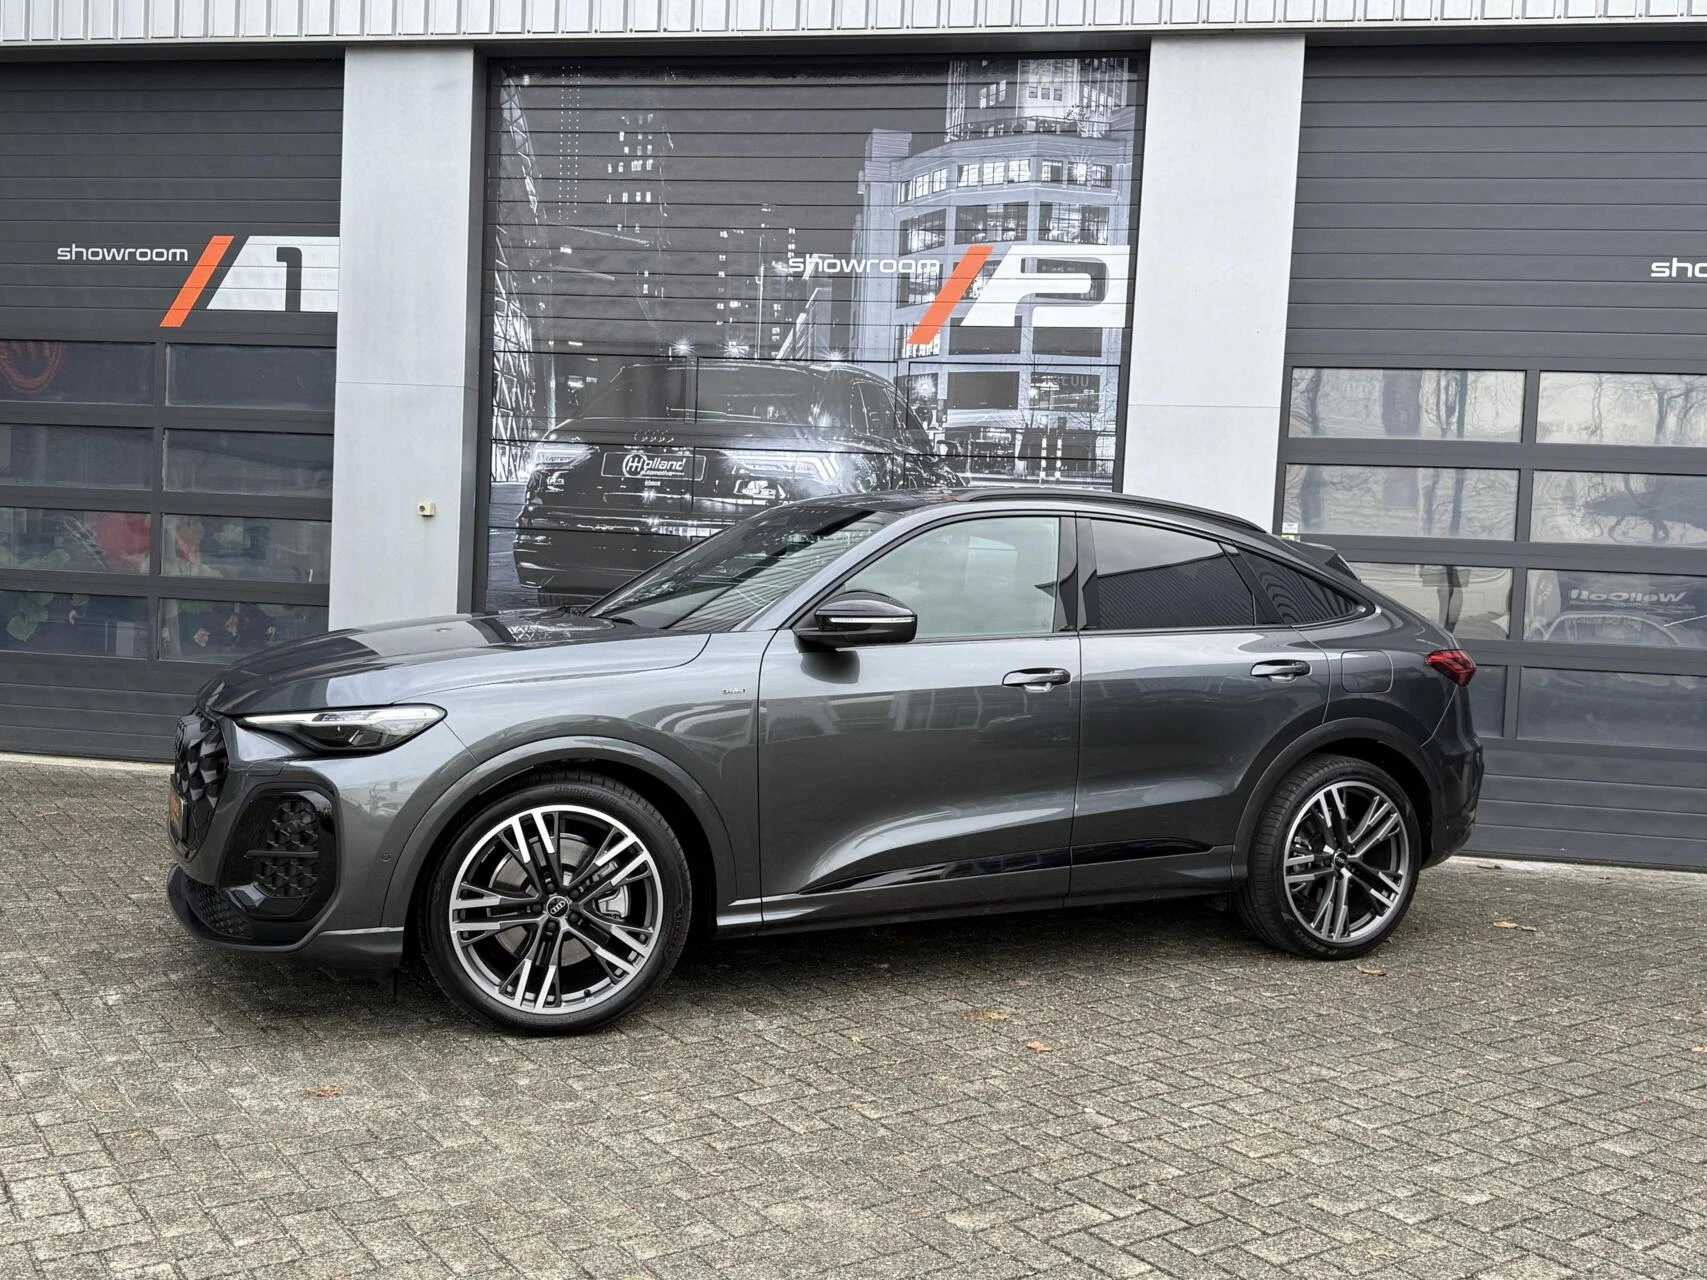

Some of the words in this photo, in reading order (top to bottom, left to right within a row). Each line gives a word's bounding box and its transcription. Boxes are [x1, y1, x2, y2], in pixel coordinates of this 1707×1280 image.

[57, 244, 188, 262] showroom
[788, 254, 941, 273] showroom
[623, 454, 686, 476] Holland
